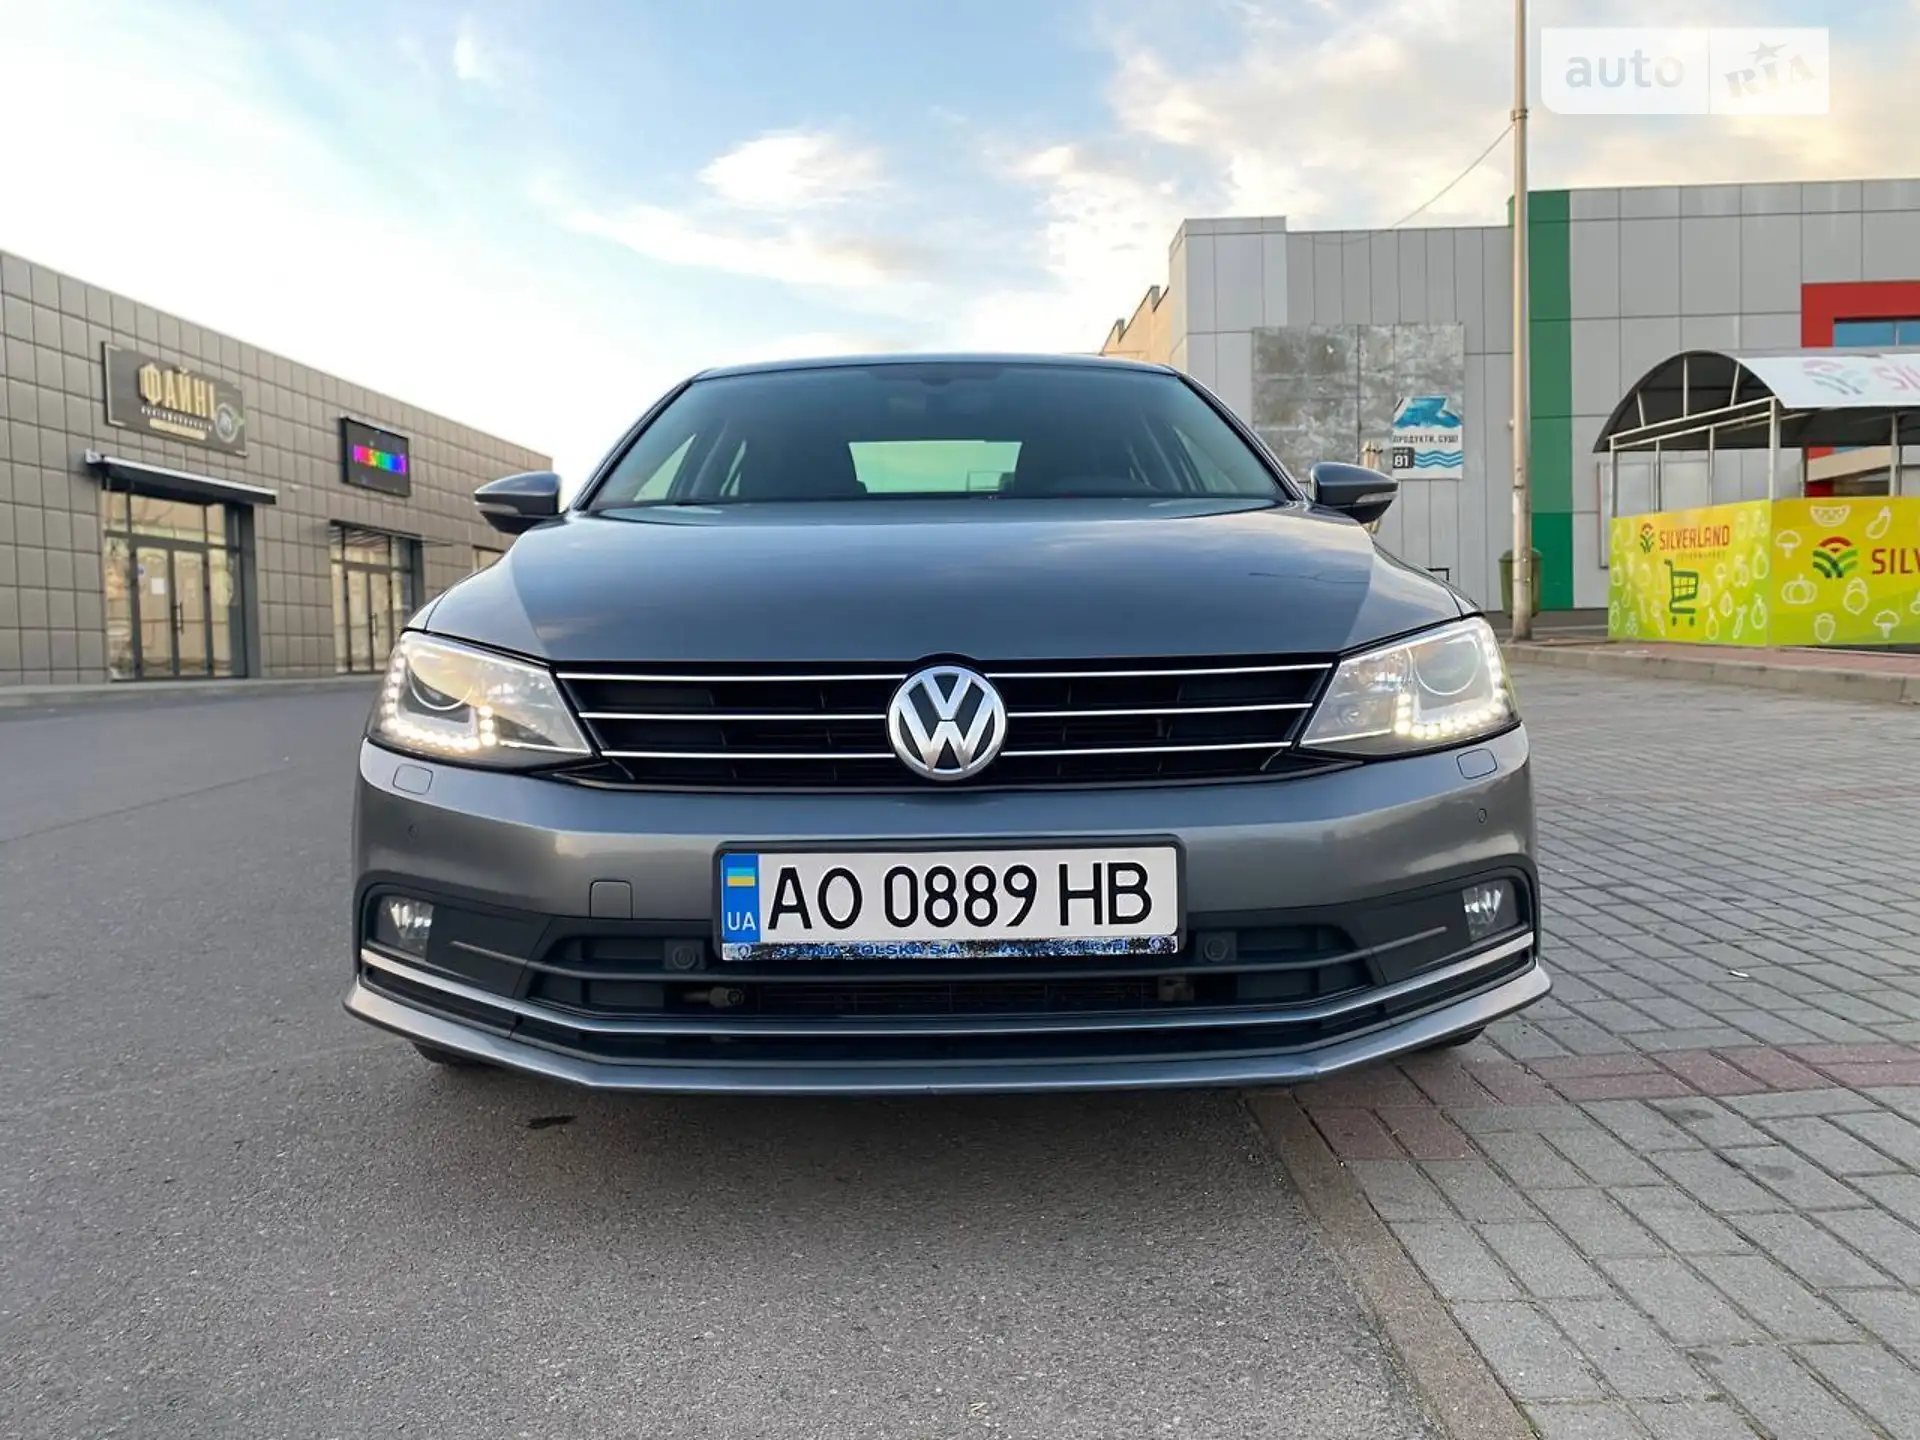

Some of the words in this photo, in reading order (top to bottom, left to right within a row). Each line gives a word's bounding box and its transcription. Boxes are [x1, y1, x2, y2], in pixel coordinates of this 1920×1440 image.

[139, 362, 215, 421] ФАЙНІ
[1394, 455, 1409, 467] 81
[1659, 524, 1730, 552] SILVERLAND
[767, 866, 863, 930] AO
[884, 864, 1038, 928] 0889
[1058, 861, 1153, 926] HB
[727, 911, 757, 932] UA
